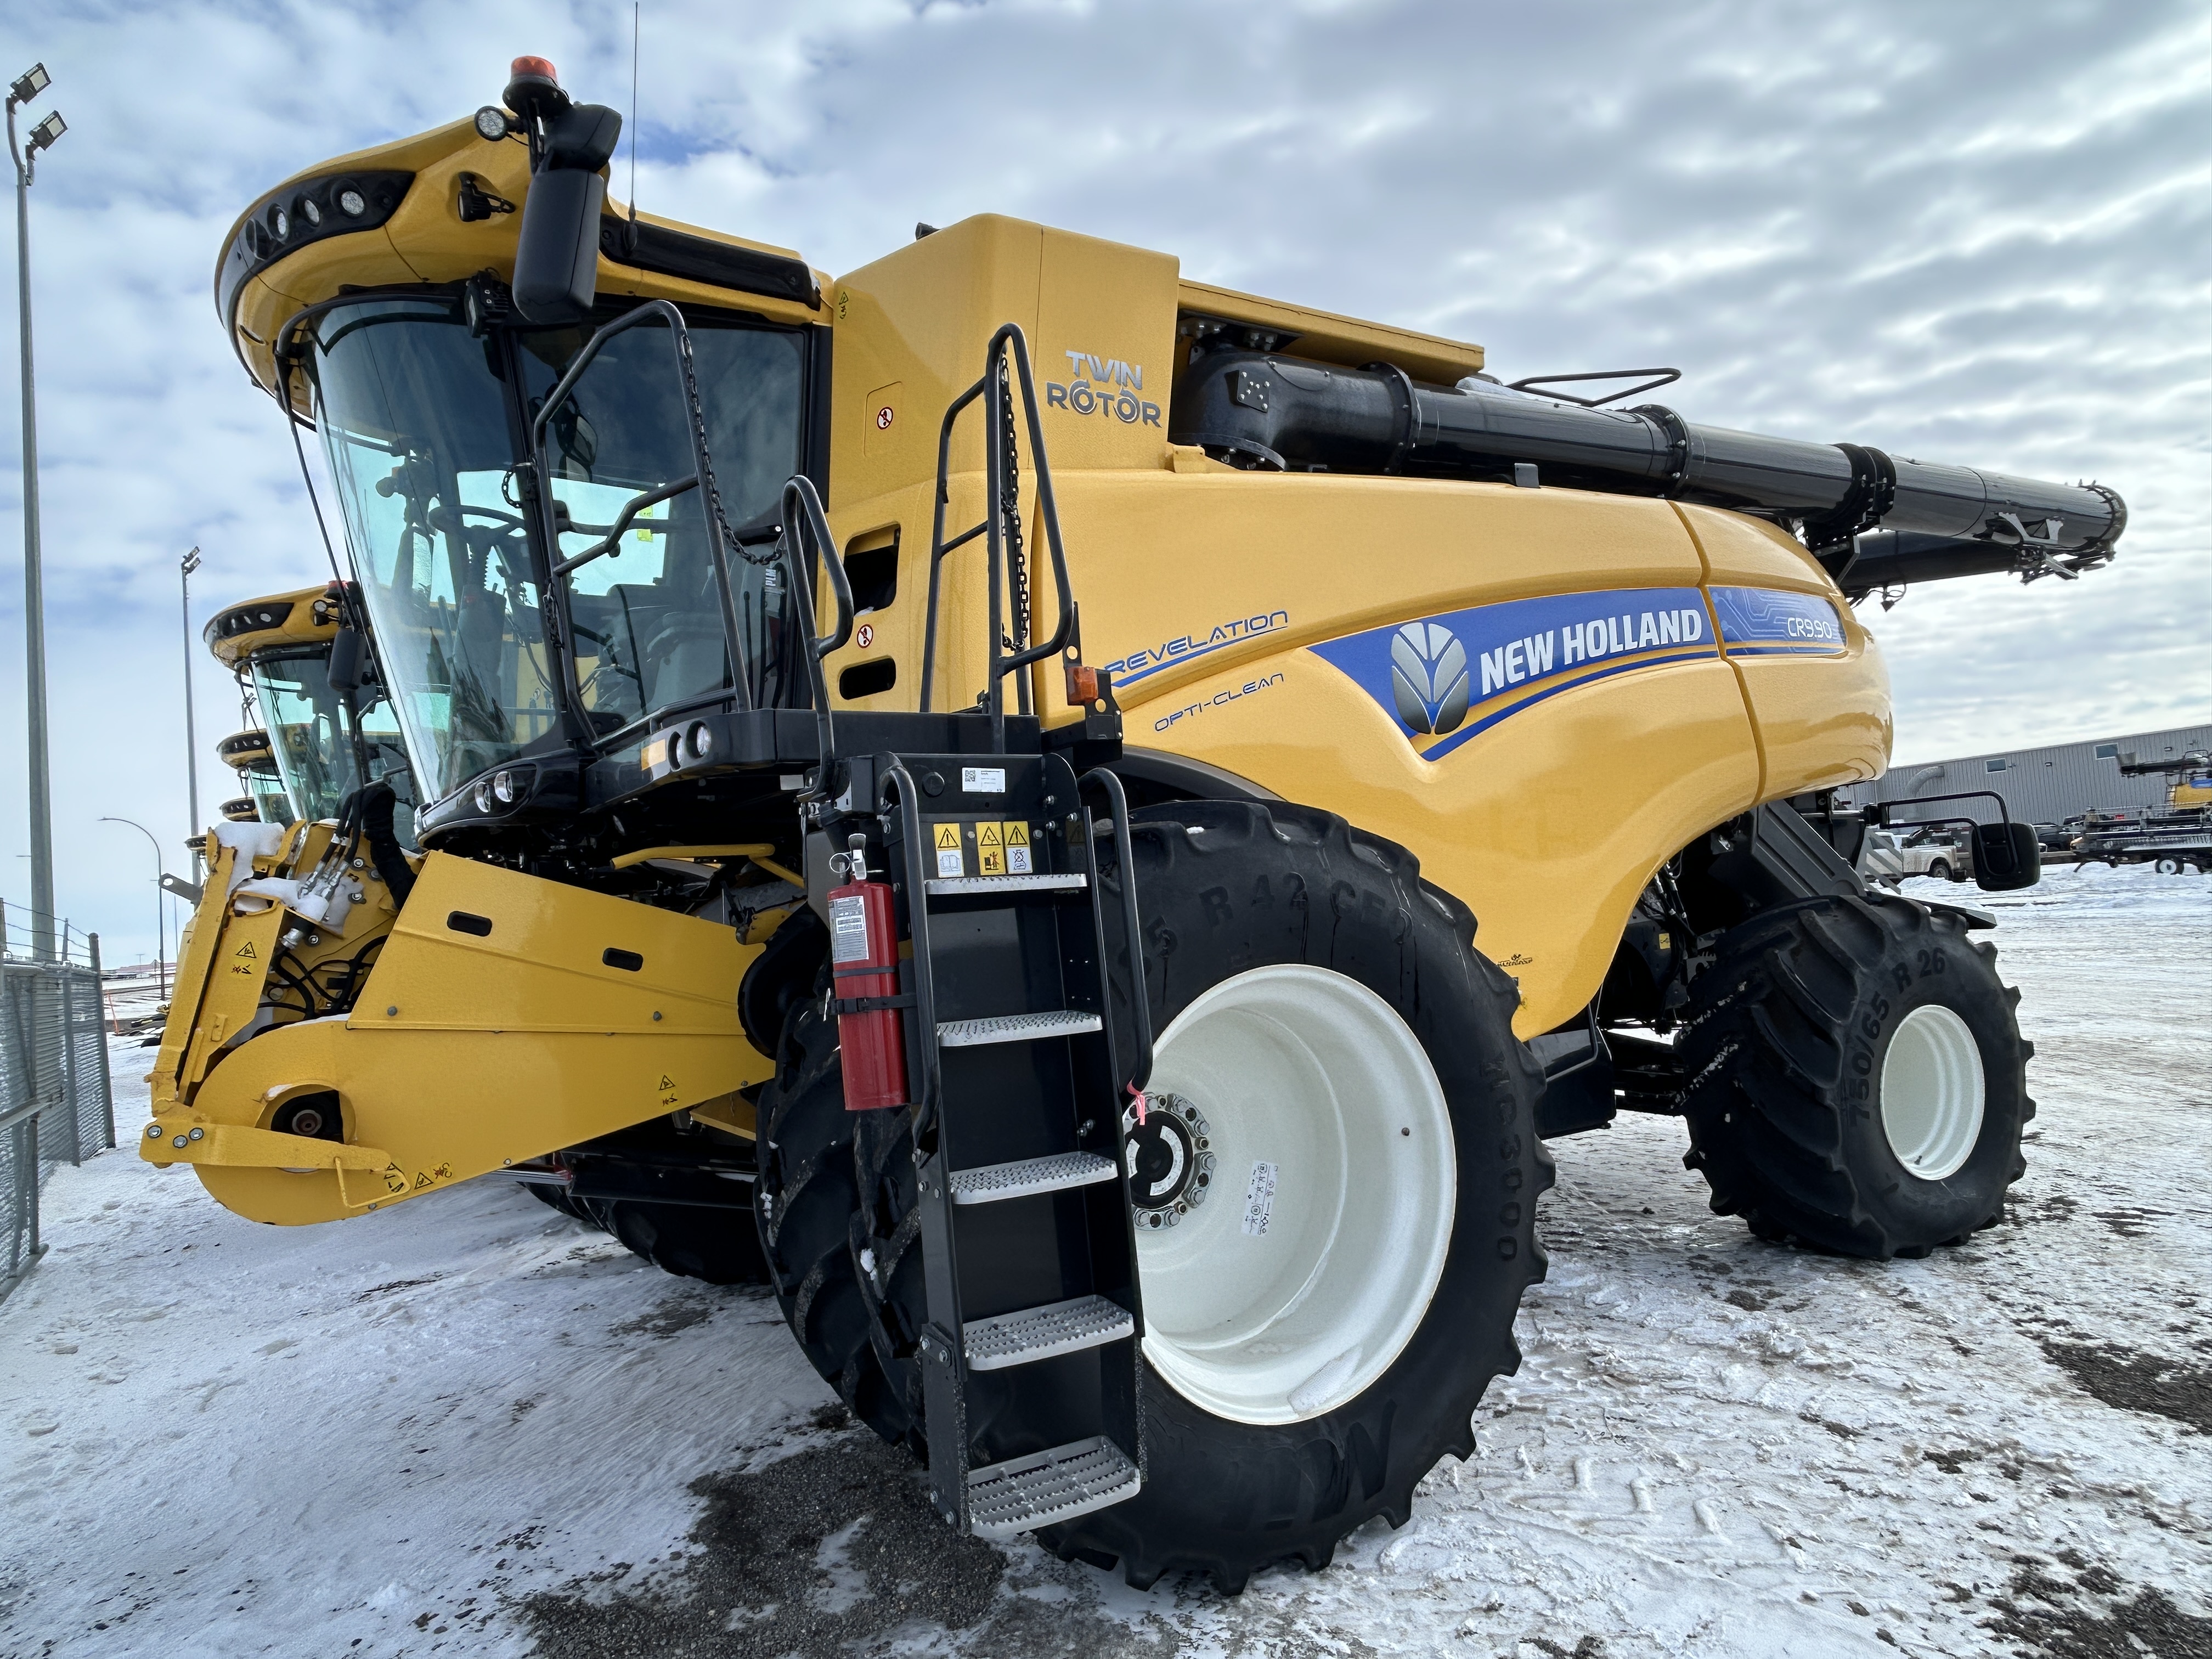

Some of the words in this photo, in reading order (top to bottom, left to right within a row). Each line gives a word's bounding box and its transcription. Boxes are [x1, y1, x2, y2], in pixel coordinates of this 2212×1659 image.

[1065, 350, 1142, 390] TWIN
[1046, 379, 1162, 428] ROTOR
[1104, 610, 1288, 673] REVELATION
[1481, 630, 1554, 695] NEW
[1562, 610, 1702, 665] HOLLAND
[1787, 617, 1832, 639] CR9.90
[1155, 673, 1284, 731] OPTI-CLEAN
[1198, 885, 1234, 927] R
[1251, 871, 1308, 911] 42
[1848, 991, 1889, 1125] 750/65
[1892, 962, 1912, 994] R
[1917, 947, 1946, 978] 26
